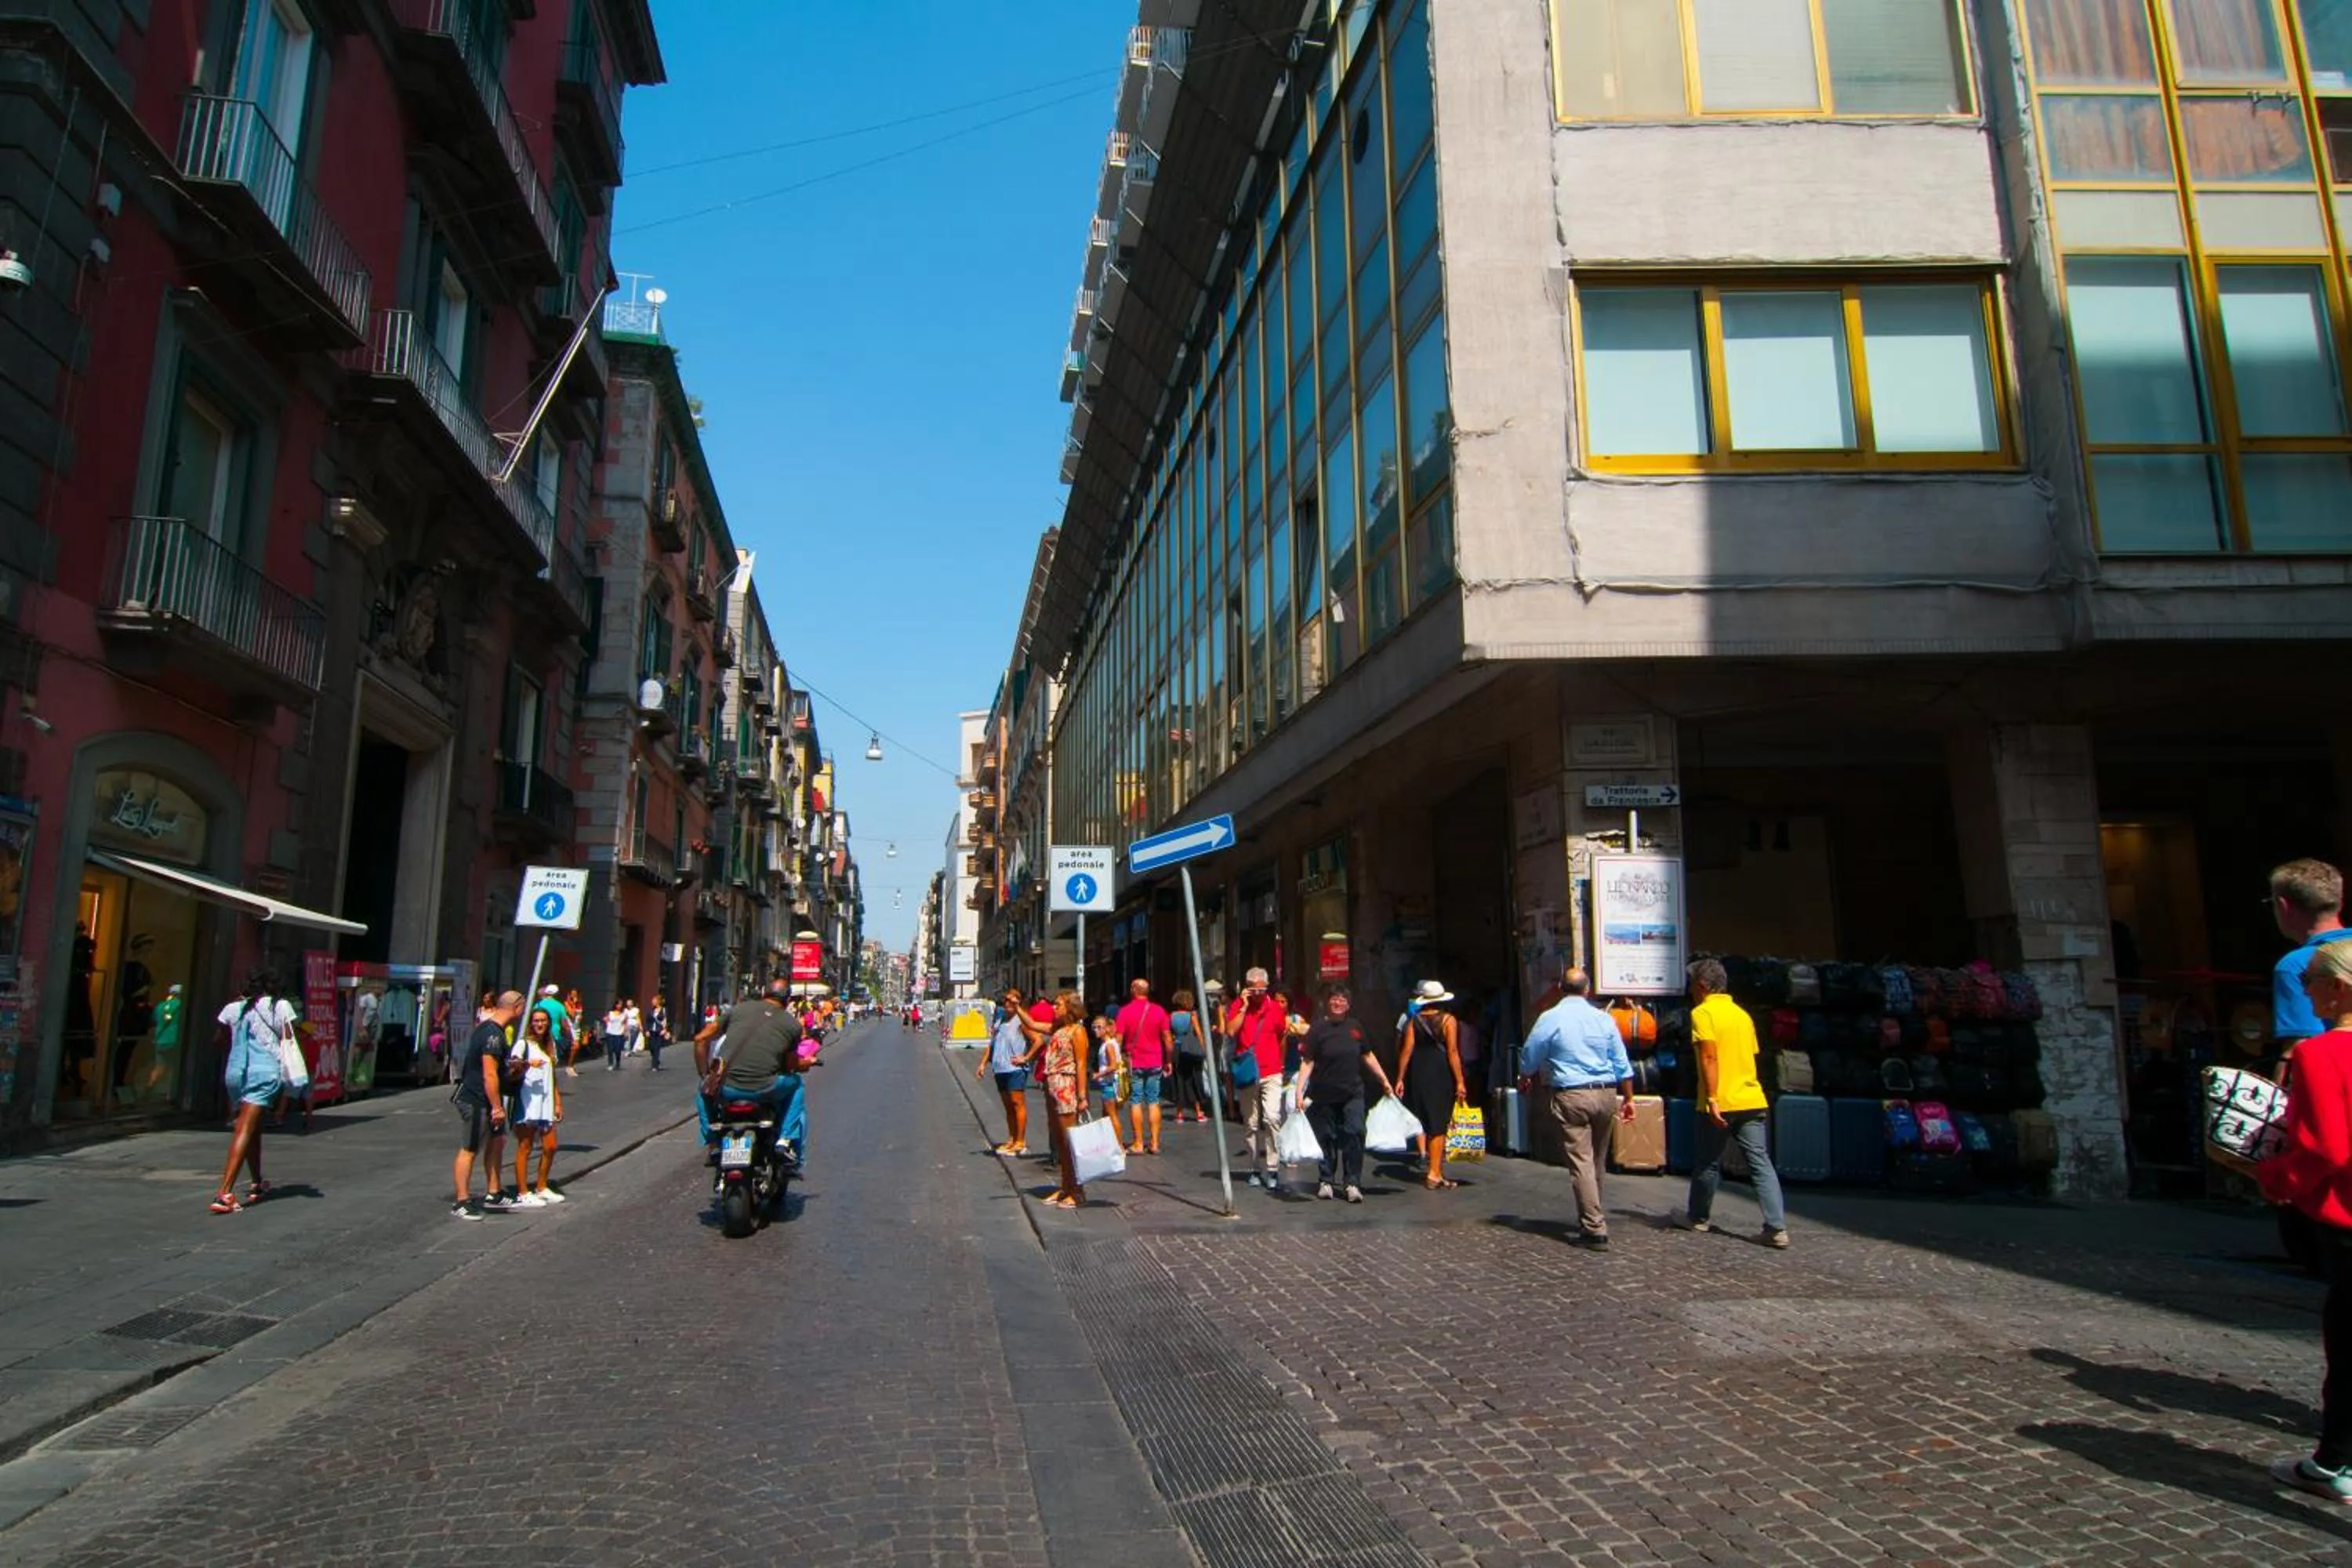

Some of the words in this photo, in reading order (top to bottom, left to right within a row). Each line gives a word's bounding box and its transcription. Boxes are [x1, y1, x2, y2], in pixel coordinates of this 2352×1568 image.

[1604, 786, 1649, 795] Trattoria
[1607, 796, 1661, 805] Francesca
[1058, 860, 1105, 869] pedonale
[532, 880, 576, 889] pedonale
[307, 956, 336, 989] OUTLET
[309, 1004, 338, 1022] TOTAL
